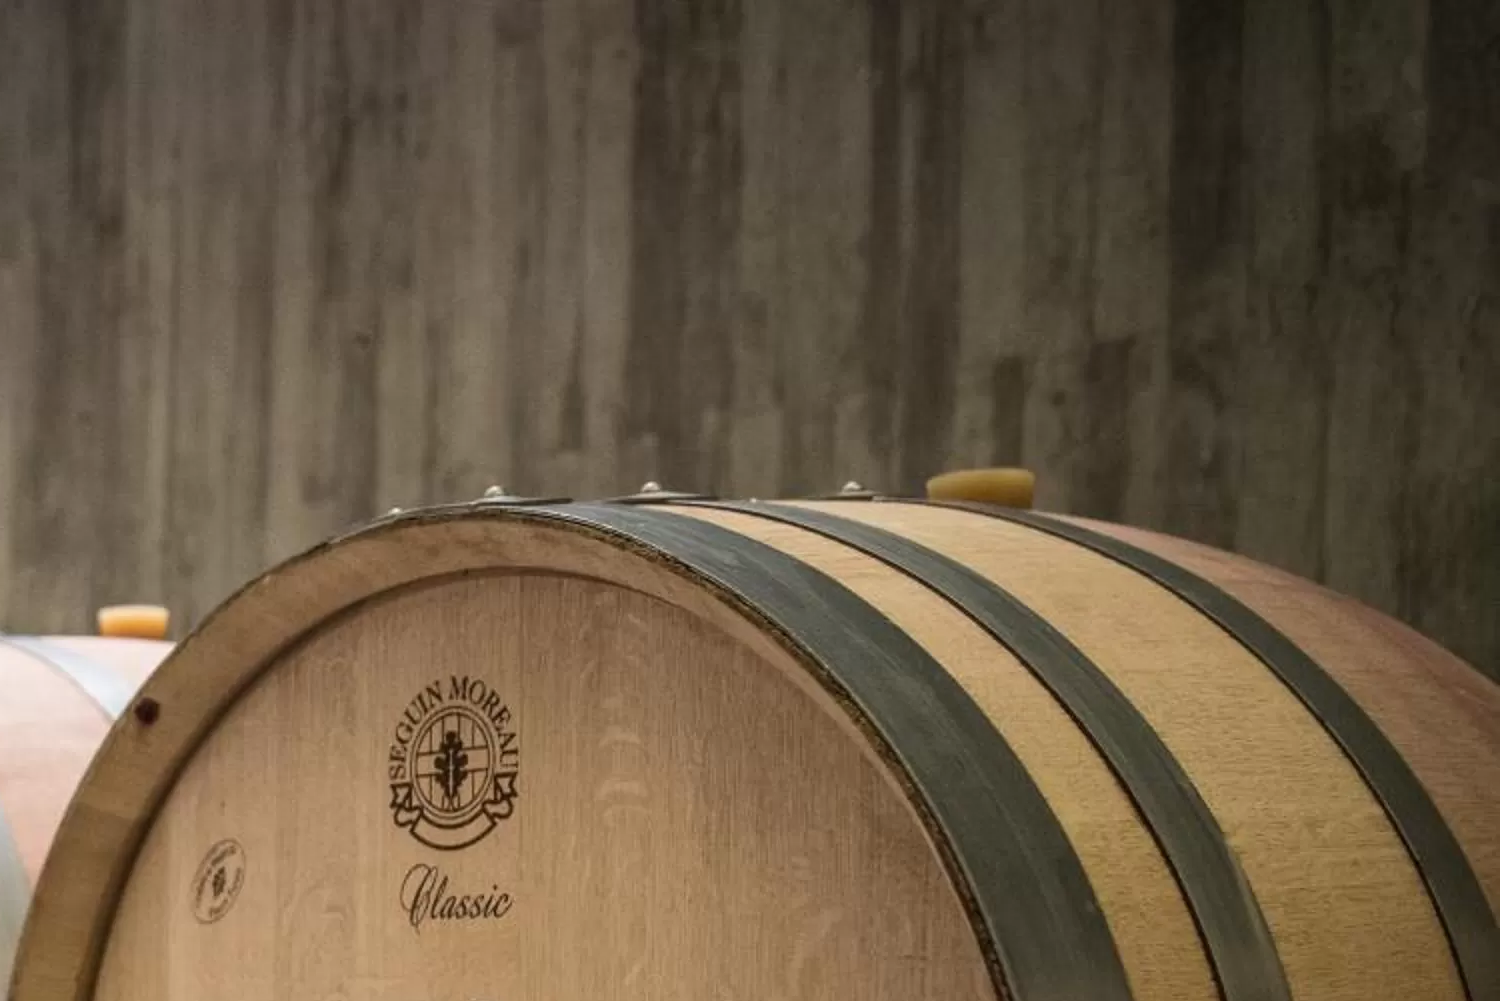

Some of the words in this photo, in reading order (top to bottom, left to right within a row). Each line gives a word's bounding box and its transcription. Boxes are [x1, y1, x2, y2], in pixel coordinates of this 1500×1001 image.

[389, 680, 444, 780] SEGUIN
[449, 676, 519, 769] MOREAU
[400, 863, 512, 934] Classic
